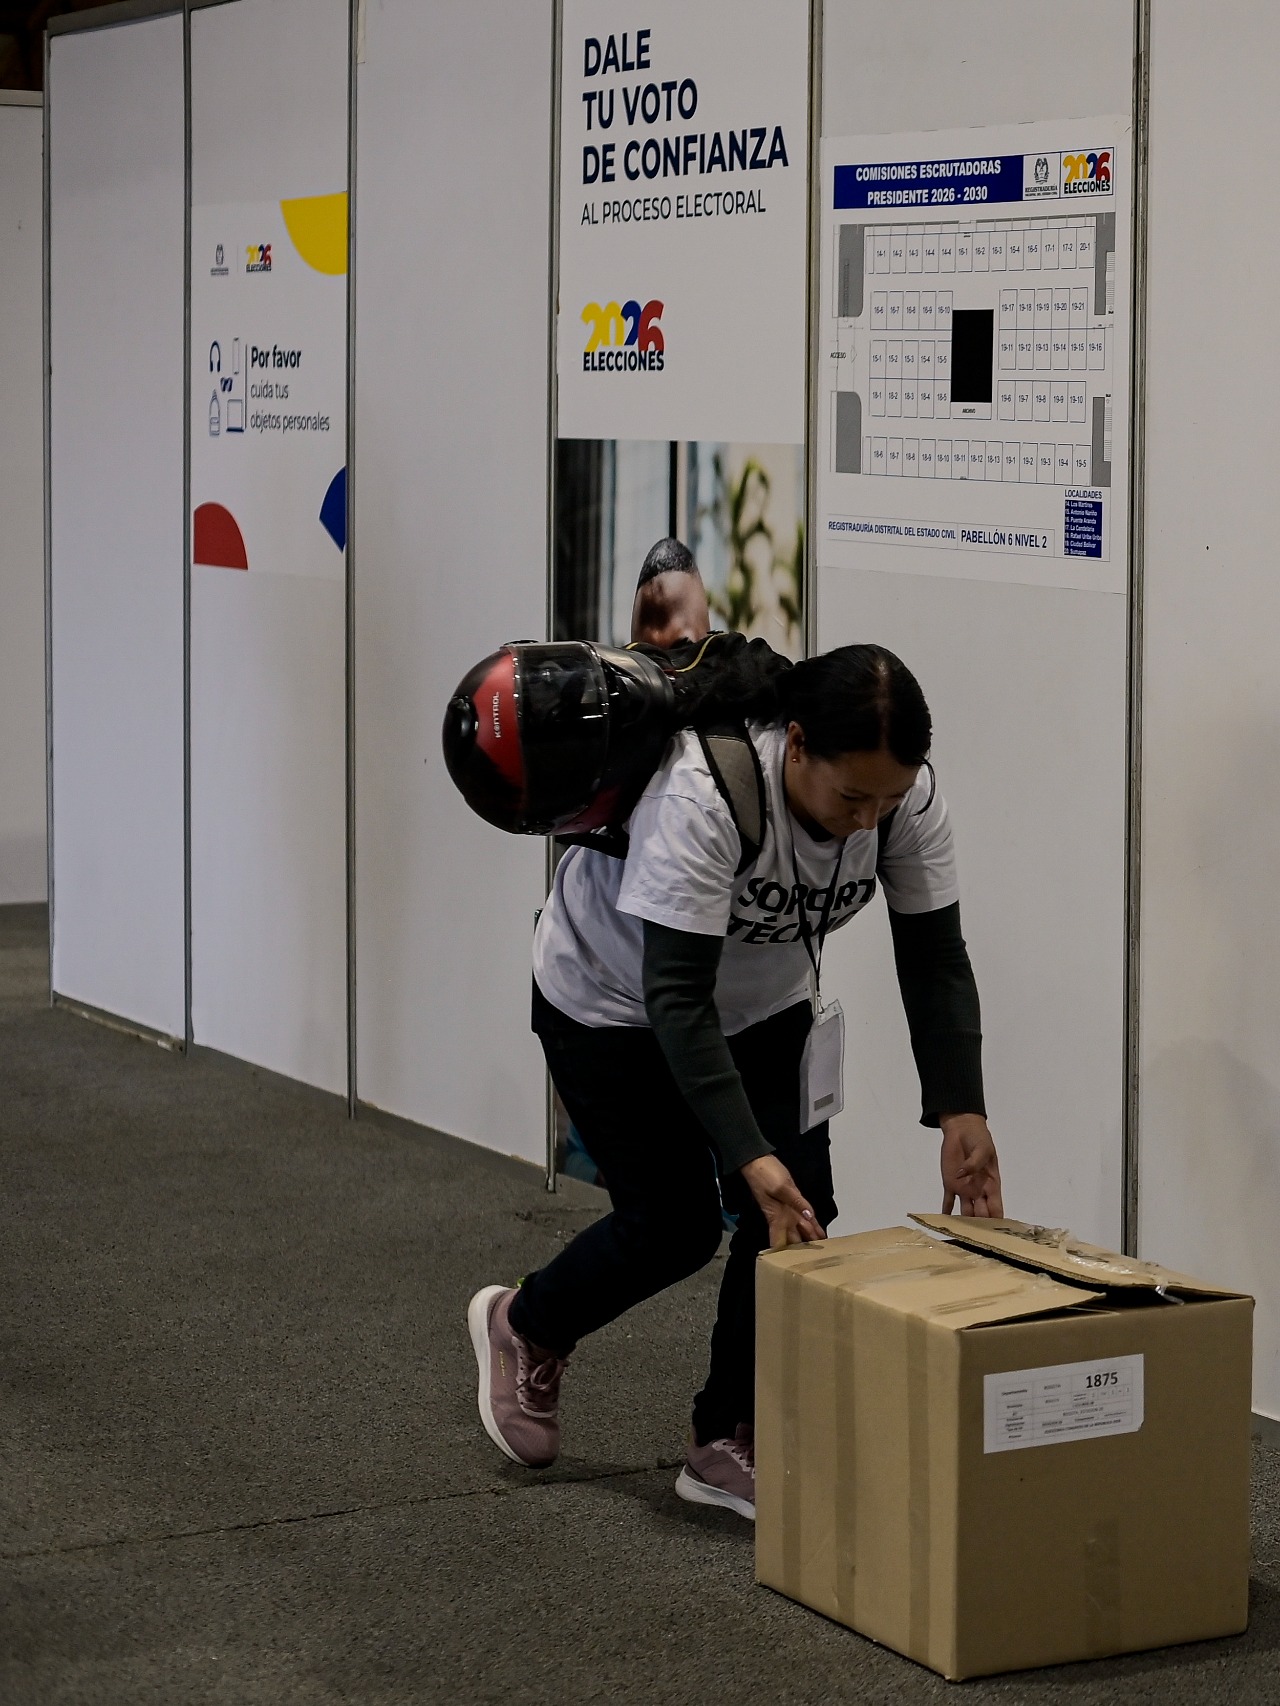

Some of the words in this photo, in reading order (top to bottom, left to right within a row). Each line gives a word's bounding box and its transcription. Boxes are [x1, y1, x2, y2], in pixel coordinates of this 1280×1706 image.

[584, 29, 651, 77] DALE
[583, 88, 614, 130] TU
[622, 78, 698, 126] VOTO
[583, 143, 616, 184] DE
[624, 125, 789, 181] CONFIANZA
[856, 166, 917, 181] COMISIONES
[920, 160, 1001, 178] ESCRUTADORAS
[1063, 152, 1110, 182] 2026
[867, 189, 928, 205] PRESIDENTE
[931, 188, 955, 202] 2026
[963, 186, 988, 201] 2030
[1064, 180, 1111, 194] ELECCIONES
[581, 203, 598, 225] AL
[602, 196, 671, 224] PROCESO
[676, 189, 766, 218] ELECTORAL
[580, 300, 664, 352] 2026
[251, 346, 269, 368] Por
[272, 344, 301, 368] favor
[583, 350, 664, 371] ELECCIONES
[251, 379, 273, 398] cuida
[275, 381, 289, 399] tus
[250, 411, 281, 434] objetos
[282, 412, 329, 434] personales
[1065, 489, 1102, 499] LOCALIDADES
[828, 521, 874, 533] REGISTRADURÍA
[874, 524, 903, 536] DISTRITAL
[904, 526, 915, 536] DEL
[916, 527, 940, 538] ESTADO
[941, 529, 956, 539] CIVIL
[961, 529, 1006, 546] PABELLÓN
[1008, 534, 1013, 546] 6
[1015, 534, 1040, 548] NIVEL
[1042, 536, 1047, 548] 2
[1086, 1371, 1118, 1388] 1875
